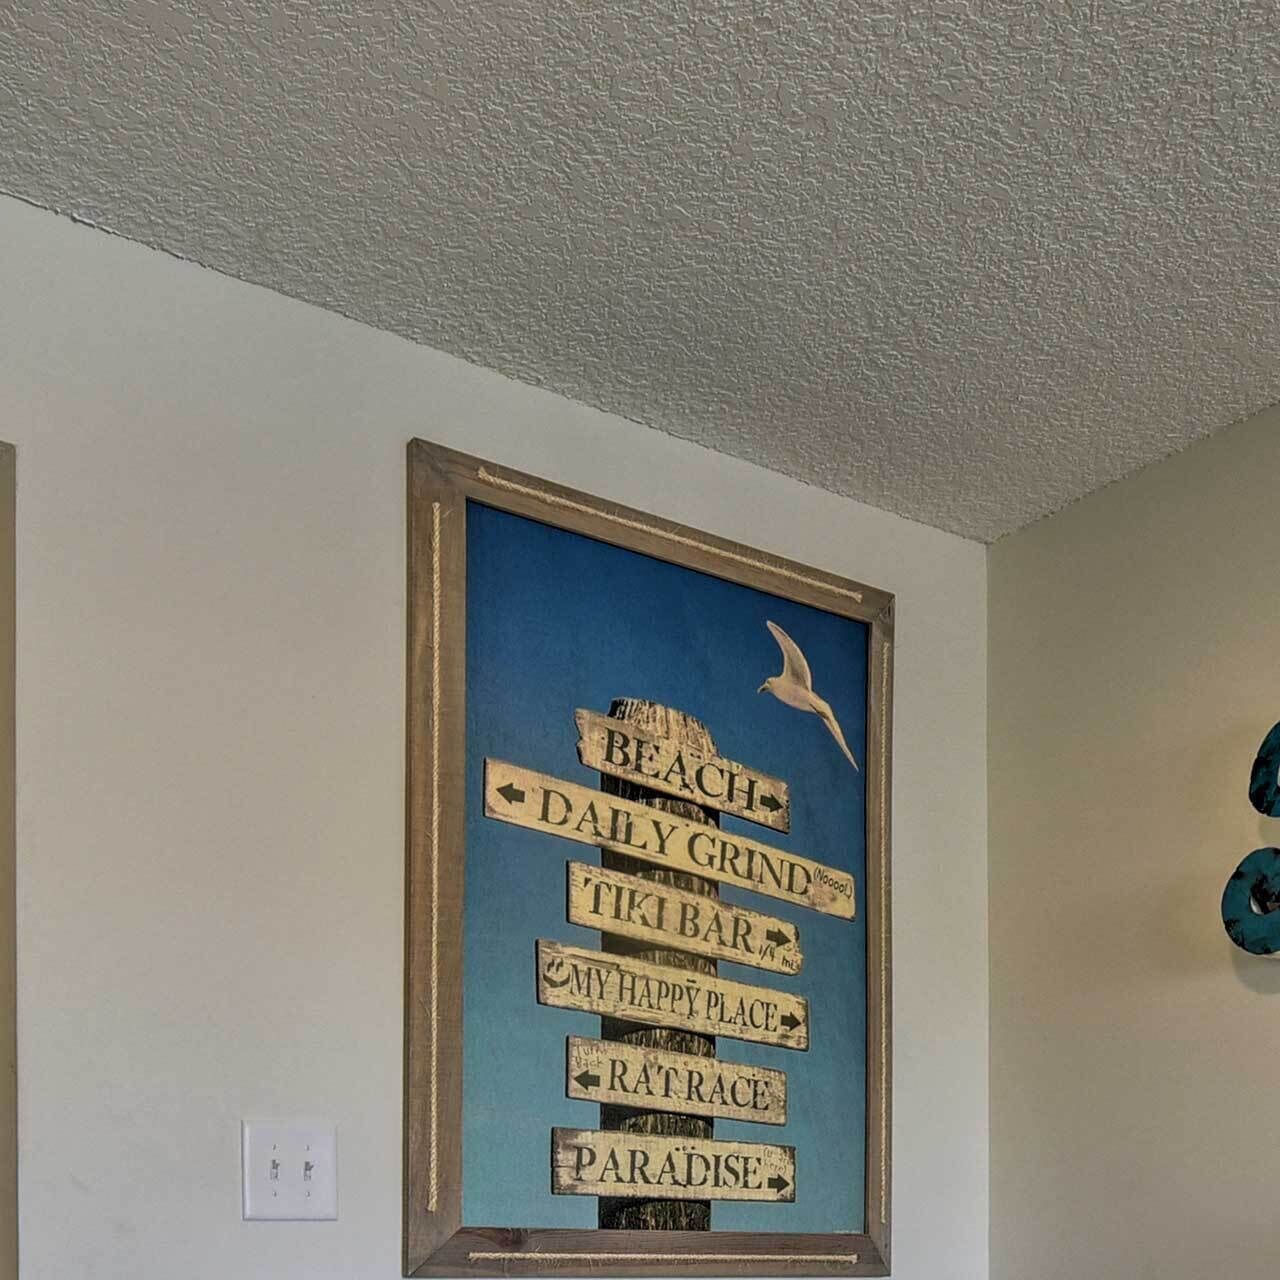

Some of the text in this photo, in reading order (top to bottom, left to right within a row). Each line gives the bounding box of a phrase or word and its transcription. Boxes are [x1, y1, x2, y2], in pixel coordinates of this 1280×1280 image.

[602, 726, 758, 812] BEACH
[537, 786, 679, 855] DAILY
[687, 830, 812, 896] GRIND
[584, 876, 755, 954] TIKI BAR
[570, 963, 779, 1032] MY HAPPY PLACE
[574, 1145, 763, 1190] PARADISE
